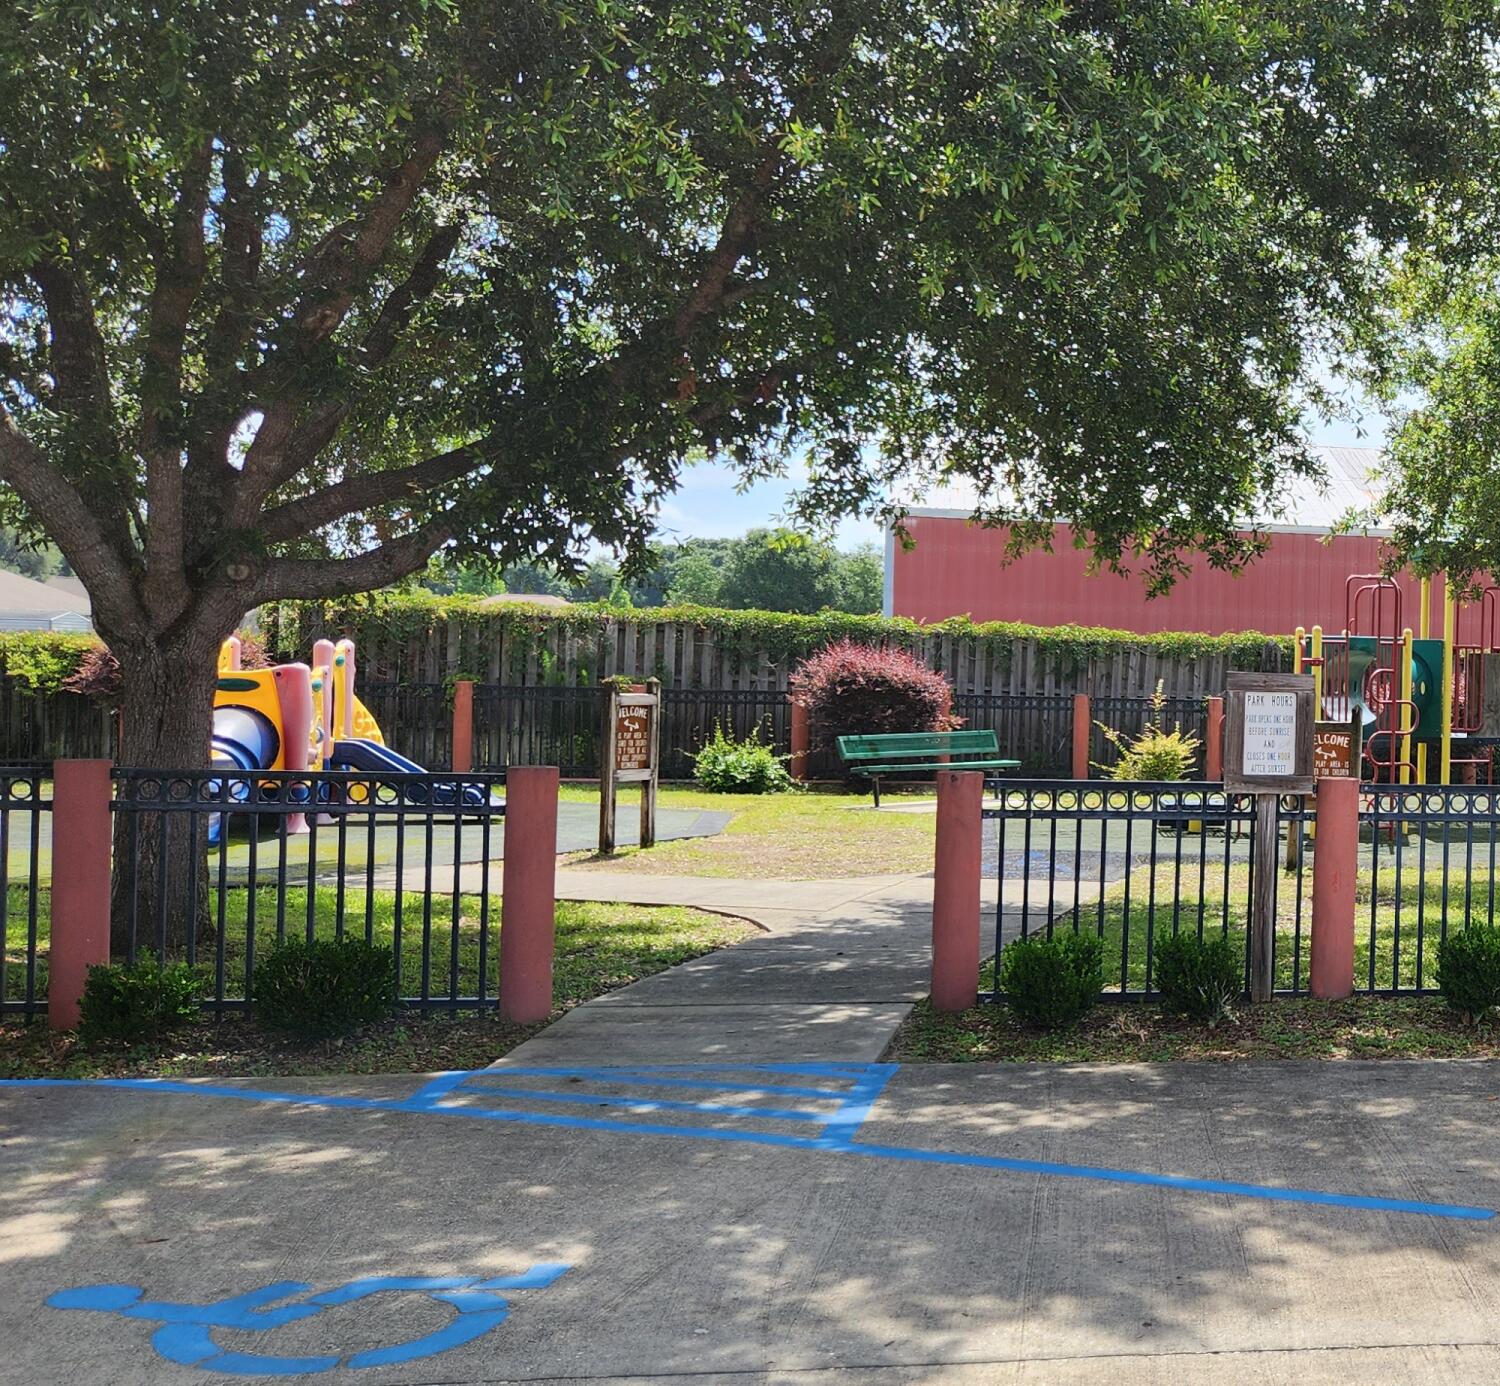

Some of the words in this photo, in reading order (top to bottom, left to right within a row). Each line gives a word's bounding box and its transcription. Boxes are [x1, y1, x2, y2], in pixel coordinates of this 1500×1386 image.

[1247, 695, 1264, 706] PARK
[1272, 696, 1293, 706] HOURS
[1248, 727, 1267, 736] BEFORE
[1269, 727, 1290, 736] SUNRISE
[1263, 740, 1275, 748] AND
[1314, 733, 1350, 748] ELCOME
[1247, 752, 1265, 761] CLOSES
[1267, 752, 1276, 761] ONE
[1277, 752, 1291, 761] HOUR
[1251, 765, 1266, 773] AFTER
[1268, 765, 1287, 774] SUNSET
